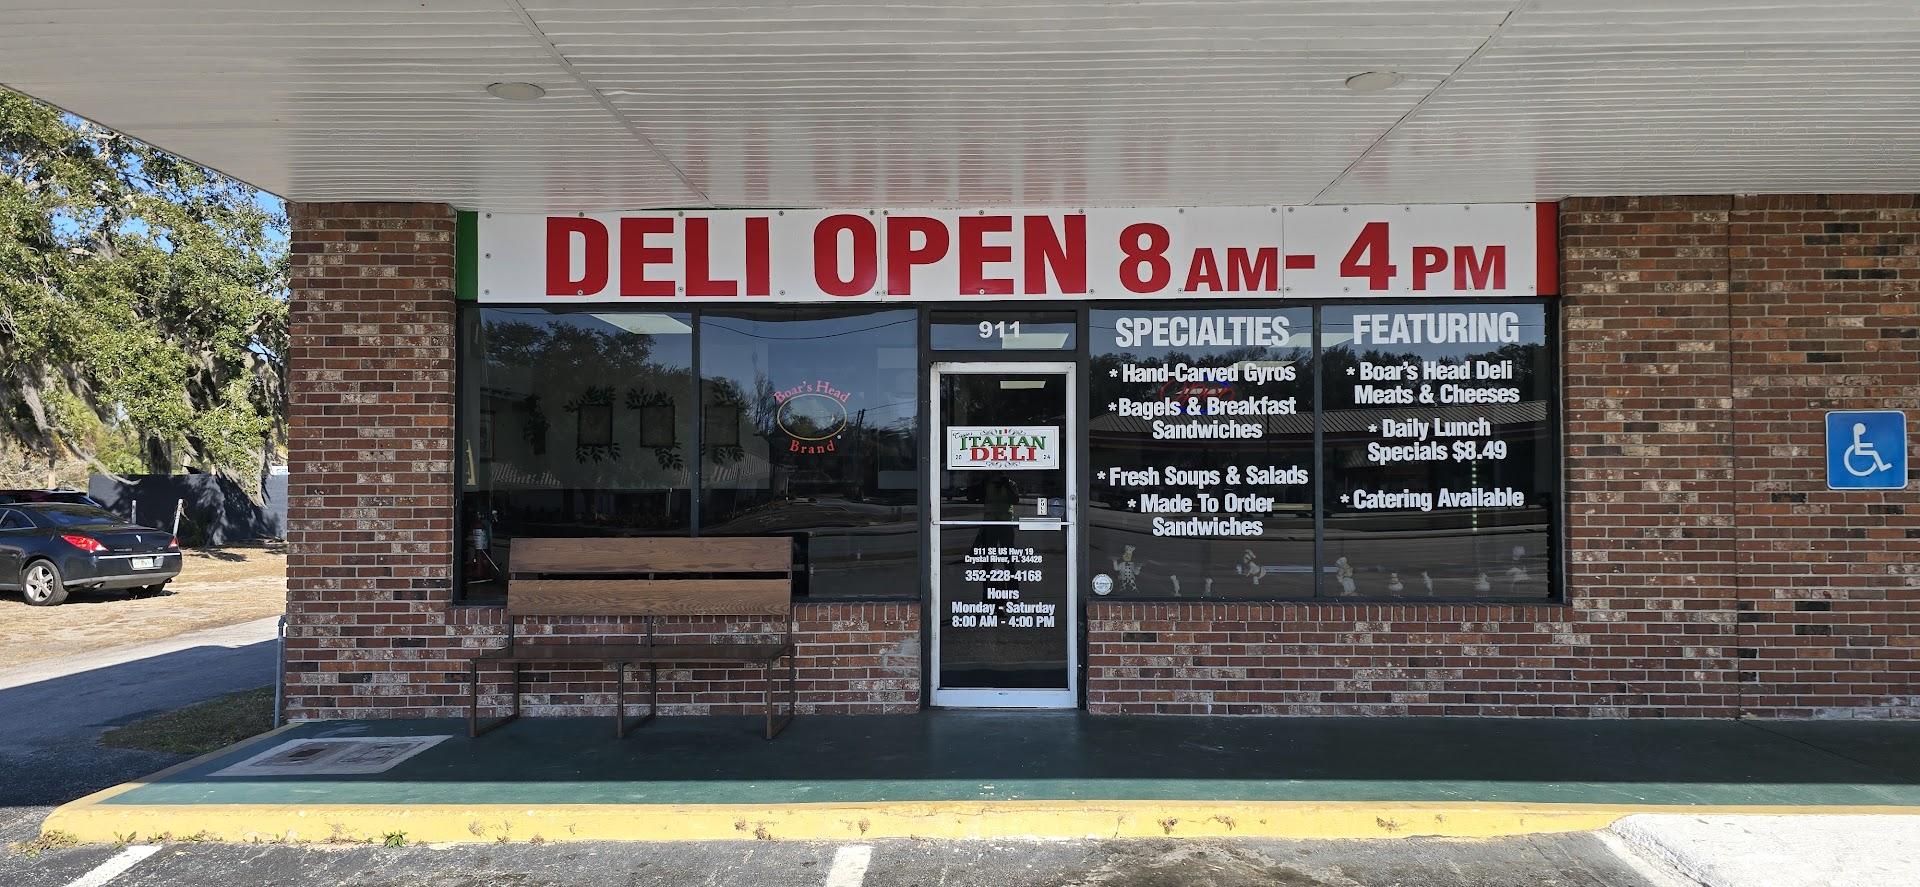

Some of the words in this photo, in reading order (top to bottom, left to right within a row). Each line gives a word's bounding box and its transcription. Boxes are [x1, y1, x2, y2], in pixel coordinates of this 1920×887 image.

[546, 216, 770, 296] DELI
[813, 214, 1087, 297] OPEN
[1118, 223, 1171, 294] 8
[1340, 222, 1397, 291] 4
[1412, 245, 1506, 290] PM
[979, 321, 1020, 338] 911
[1115, 316, 1289, 347] SPECIALTIES
[1353, 312, 1519, 344] FEATURING
[1123, 363, 1238, 383] Hand-Carved
[1244, 363, 1296, 385] Gyros
[1360, 362, 1418, 380] Boar's
[1424, 361, 1470, 380] Head
[1476, 361, 1512, 379] Deli
[774, 381, 812, 404] Boar's
[816, 380, 851, 402] Head
[1355, 385, 1413, 404] Meats
[1419, 384, 1434, 403] &
[1440, 385, 1519, 403] Cheeses
[1119, 398, 1181, 420] Bagels
[1187, 397, 1201, 416] &
[1207, 397, 1296, 416] Breakfast
[1153, 421, 1262, 439] Sandwiches
[1383, 419, 1429, 441] Daily
[1434, 418, 1490, 436] Lunch
[790, 440, 835, 454] Brand
[960, 436, 1046, 450] ITALIAN
[1368, 442, 1447, 465] Specials
[1452, 440, 1506, 462] $8.49
[970, 447, 1037, 461] DELI
[1110, 467, 1159, 486] Fresh
[1165, 466, 1220, 489] Soups
[1226, 466, 1241, 484] &
[1246, 466, 1308, 484] Salads
[1141, 494, 1192, 513] Made
[1198, 494, 1218, 512] To
[1225, 494, 1274, 512] Order
[1353, 489, 1432, 511] Catering
[1438, 488, 1524, 507] Available
[1153, 517, 1263, 536] Sandwiches
[965, 556, 989, 564] Crystal
[990, 556, 1009, 564] River,
[1009, 548, 1023, 556] Hwy
[965, 570, 1041, 581] 352-228-4168
[988, 588, 1019, 599] Hours
[952, 602, 995, 615] Monday
[1006, 602, 1055, 615] Saturday
[952, 616, 975, 627] 8:00
[979, 616, 997, 627] AM
[1009, 616, 1033, 627] 4:00
[1037, 616, 1055, 627] PM
